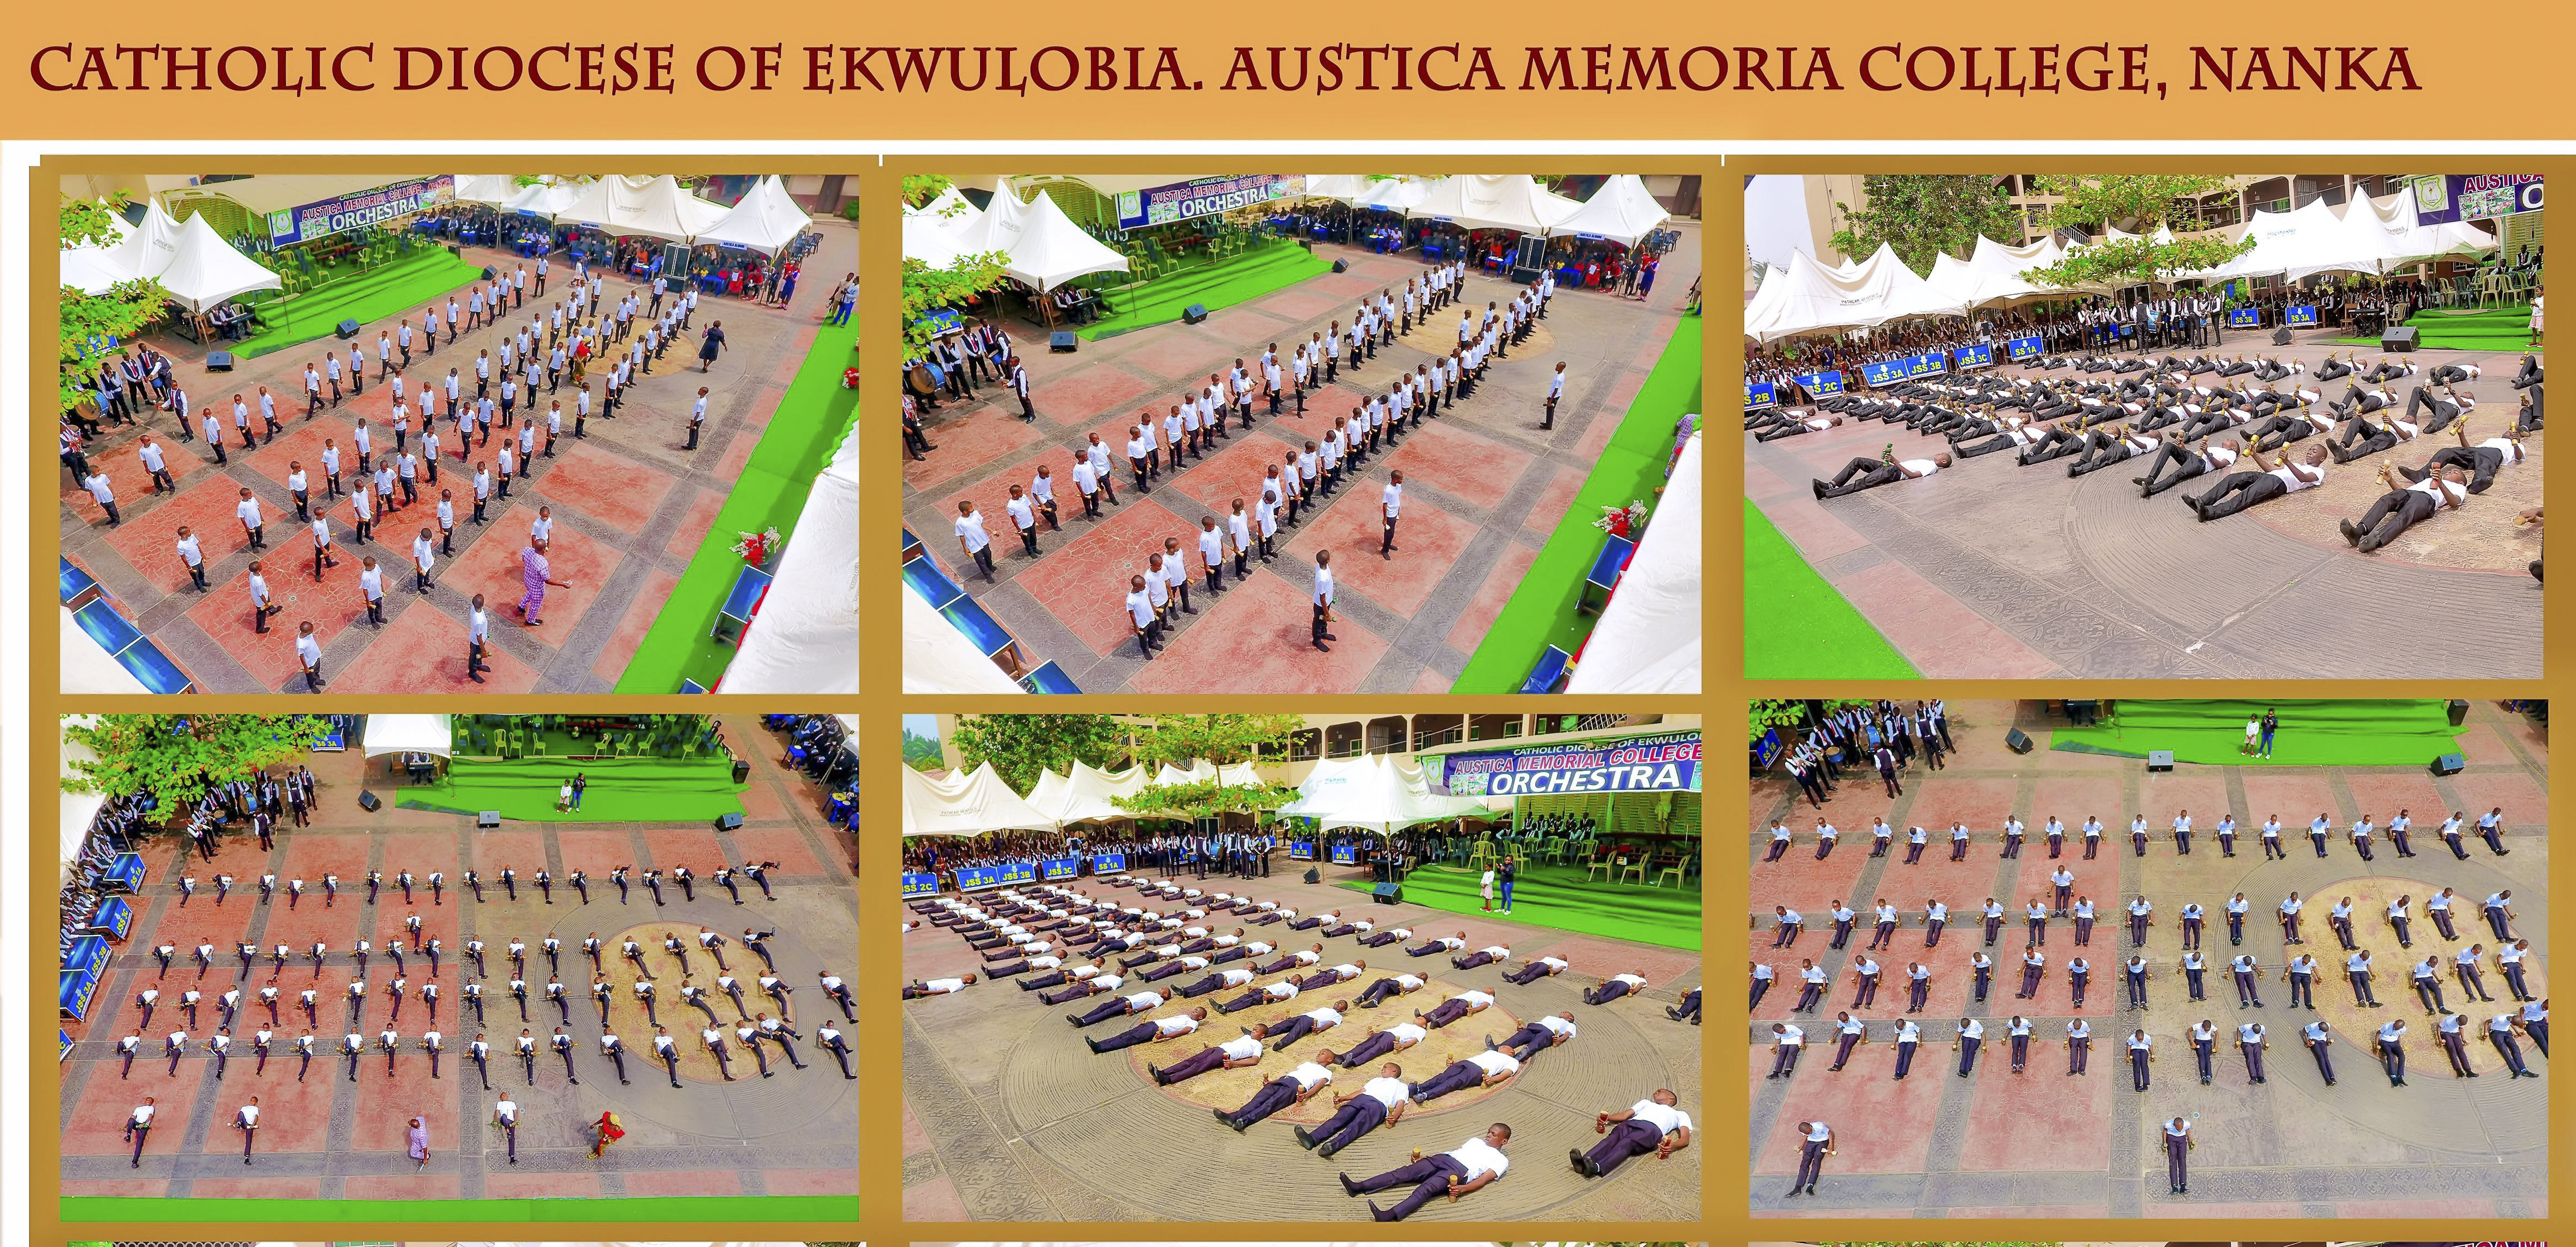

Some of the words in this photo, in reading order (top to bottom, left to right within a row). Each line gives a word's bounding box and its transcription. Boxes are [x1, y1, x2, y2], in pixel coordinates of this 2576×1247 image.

[1189, 178, 1217, 186] CATHOLIC
[339, 190, 367, 200] CATHOLIC
[1151, 188, 1193, 205] AUSTICA
[1193, 182, 1238, 198] MEMORIAL
[1182, 186, 1268, 216] ORCHESTRA
[302, 202, 343, 221] AUSTICA
[344, 194, 388, 211] MEMORIAL
[332, 197, 418, 230] ORCHESTRA
[2015, 347, 2026, 356] SS
[1960, 356, 1976, 365] JSS
[1977, 354, 1987, 362] 3C
[1911, 364, 1928, 374] JSS
[1929, 361, 1941, 371] 3B
[1872, 372, 1889, 383] JSS
[1890, 369, 1905, 379] 3A
[1823, 381, 1838, 392] 2C
[1754, 392, 1770, 403] 2B
[1513, 746, 1563, 756] CATHOLIC
[1618, 739, 1635, 748] OF
[1638, 733, 1701, 746] EKWULO
[1455, 757, 1514, 776] AUSTICA
[1516, 753, 1606, 772] MEMORIAL
[1610, 743, 1702, 765] COLLEGE
[1763, 750, 1771, 761] SS
[1492, 763, 1680, 794] ORCHESTRA
[1002, 872, 1018, 881] JSS
[1048, 867, 1062, 876] JSS
[131, 875, 137, 886] SS
[965, 877, 981, 887] JSS
[902, 884, 917, 892] SS
[920, 883, 933, 891] 2C
[116, 918, 126, 934] JSS
[122, 908, 128, 920] 3C
[91, 957, 101, 976] JSS
[99, 945, 107, 958] 3B
[76, 994, 86, 1013] JSS
[83, 981, 92, 995] 3A
